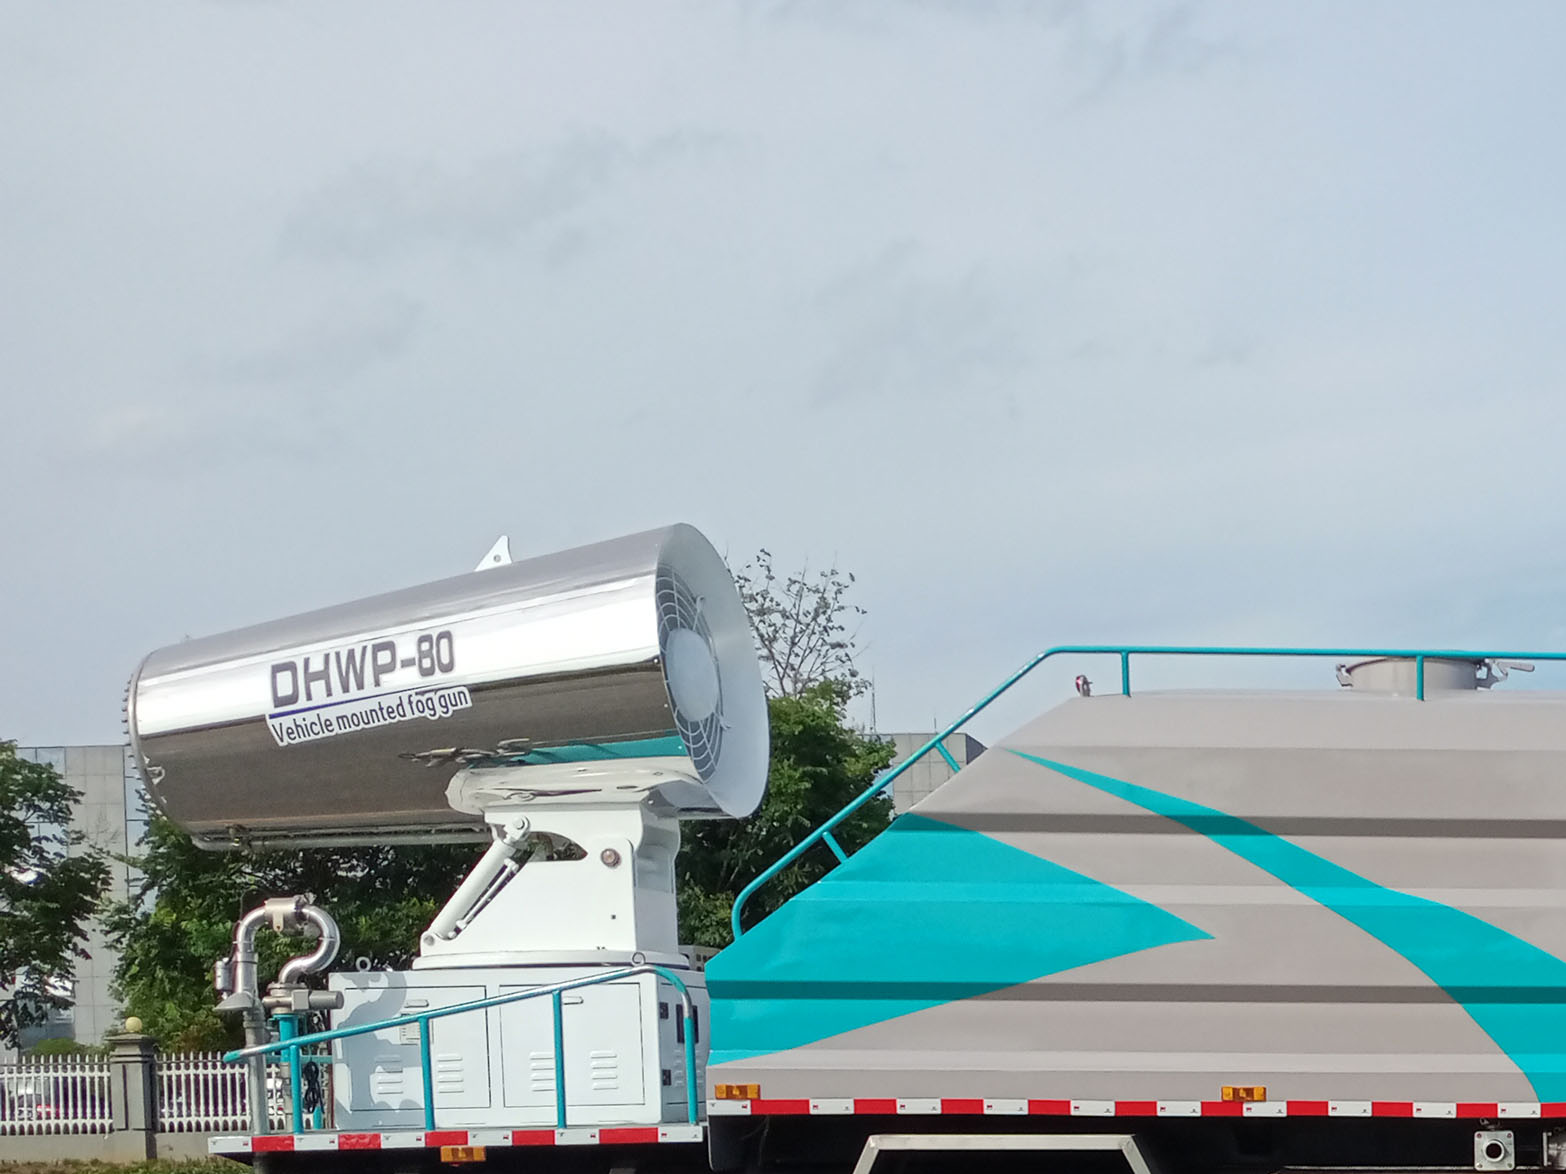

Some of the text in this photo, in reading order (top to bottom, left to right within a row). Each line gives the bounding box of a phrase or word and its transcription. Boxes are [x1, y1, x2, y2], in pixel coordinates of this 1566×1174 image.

[271, 630, 455, 709] DHWP-80
[271, 690, 469, 743] Vehicle mounted fog gun
